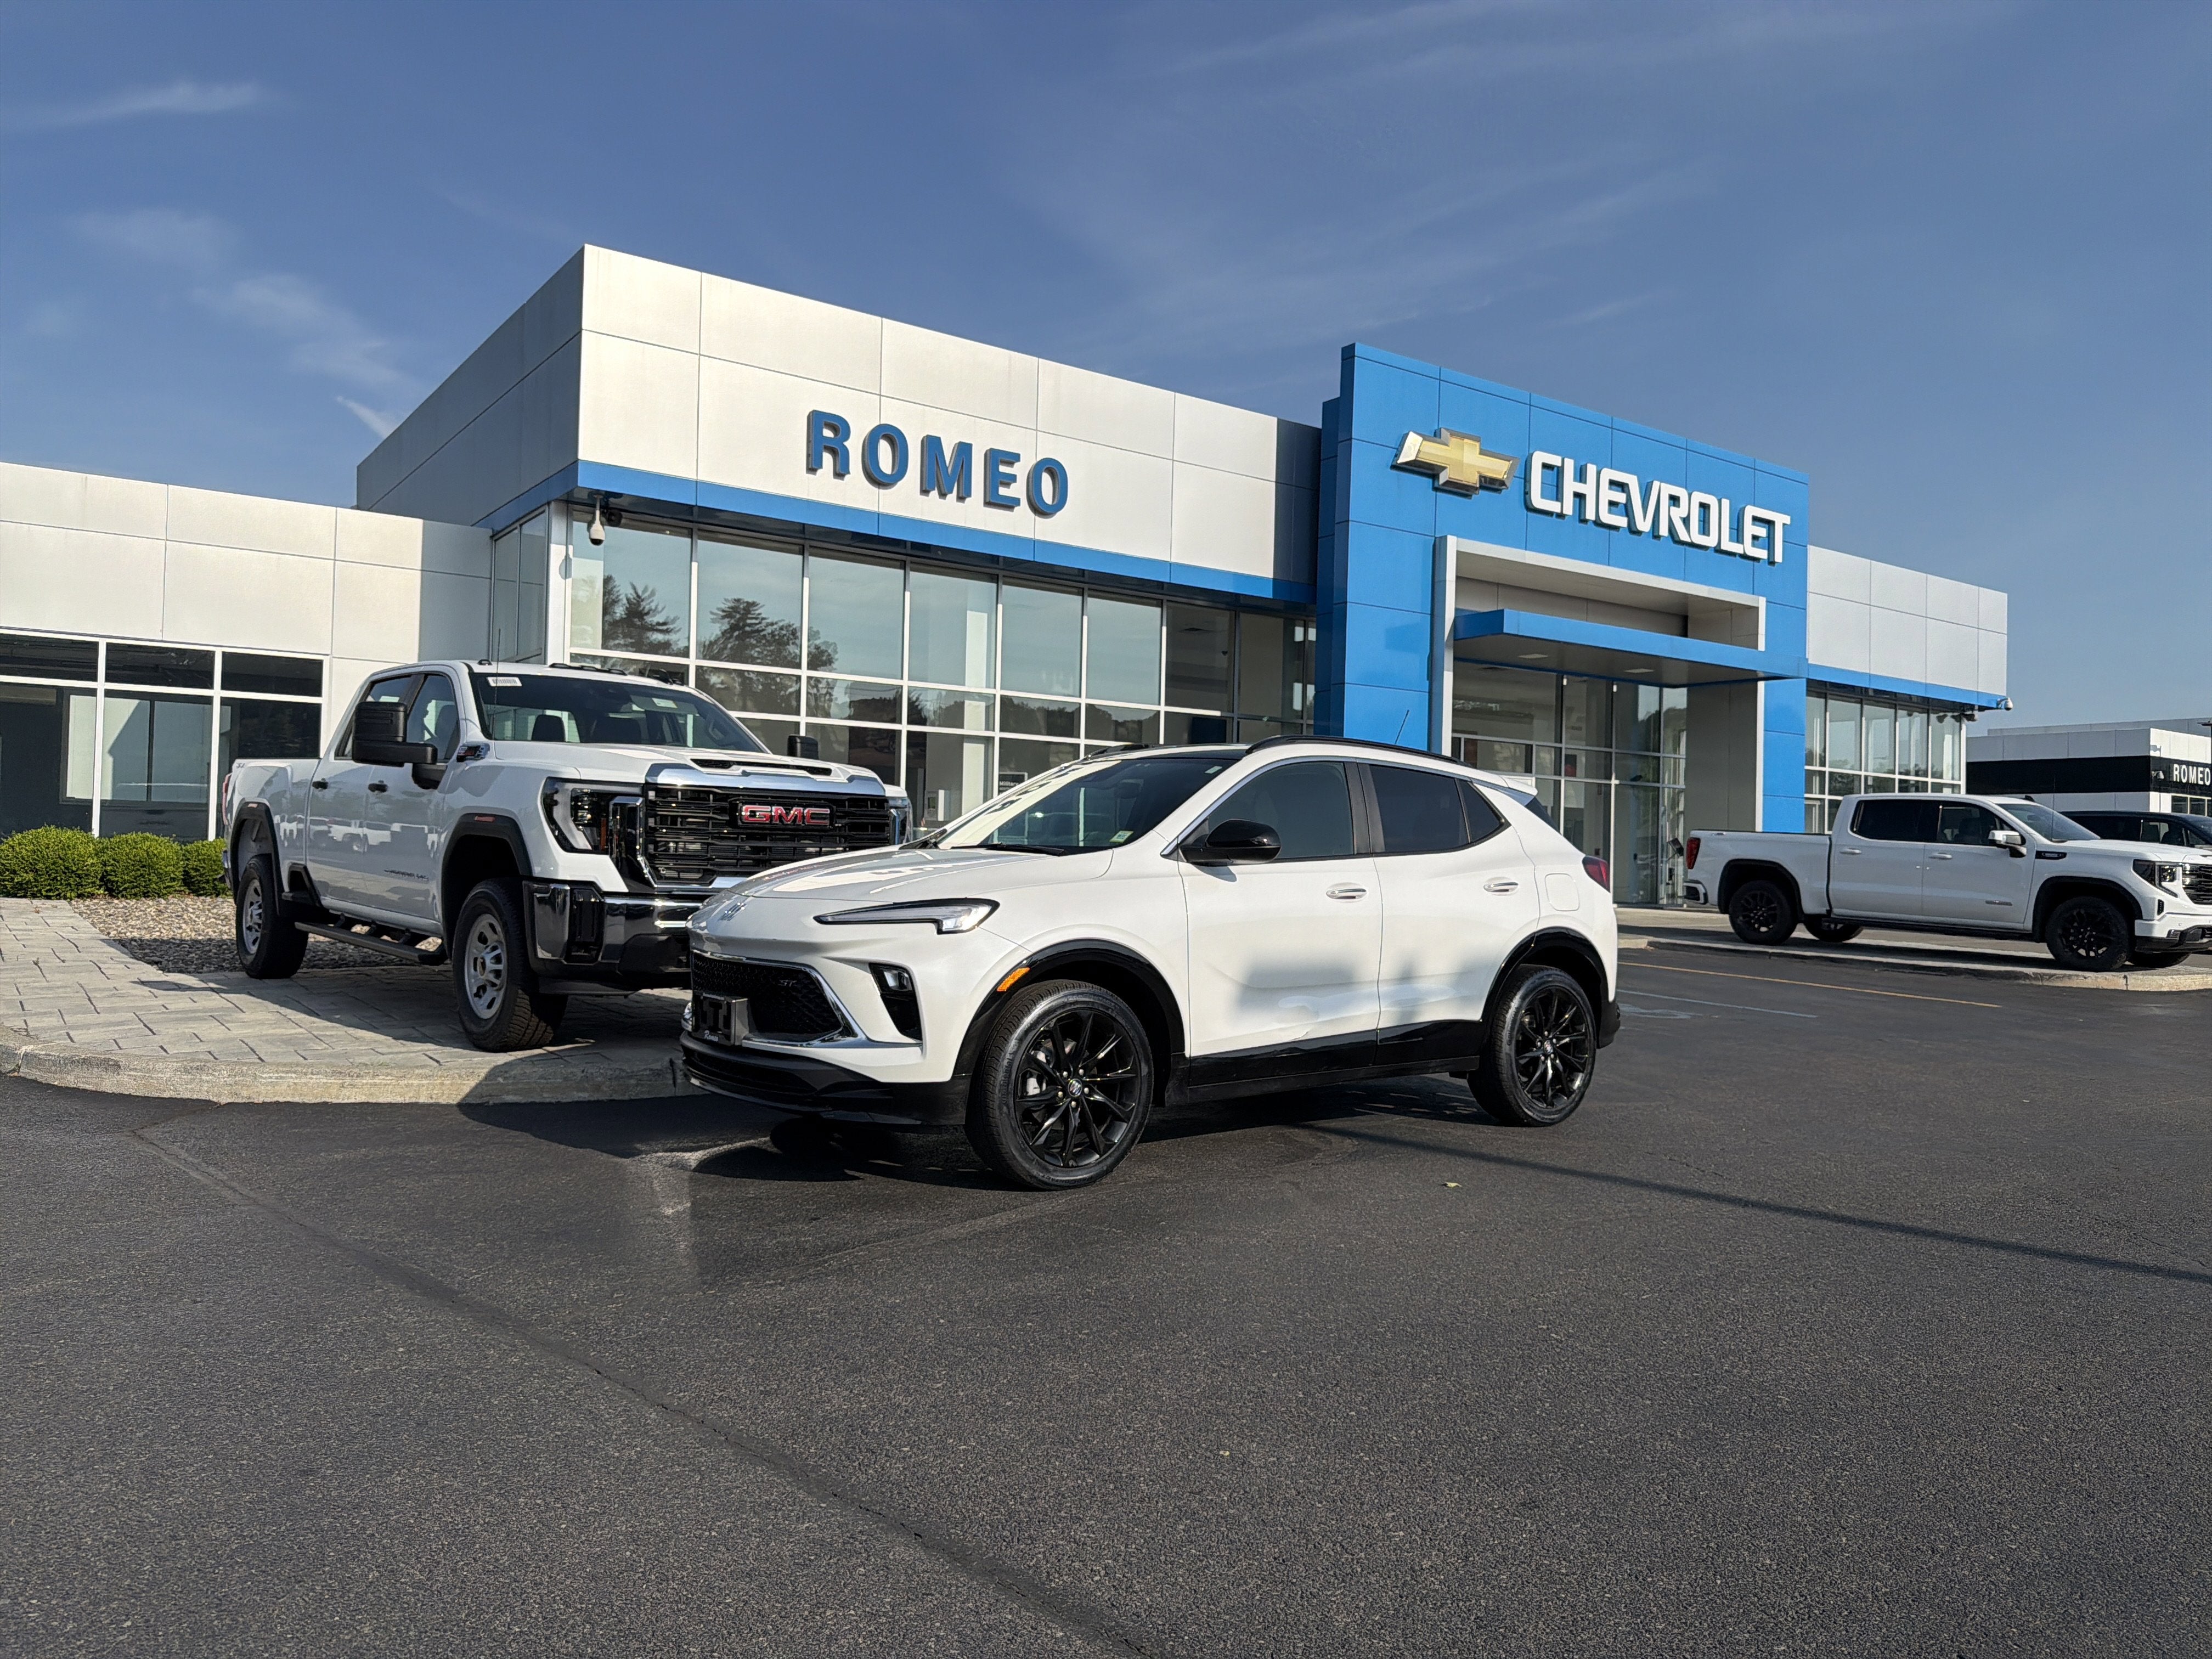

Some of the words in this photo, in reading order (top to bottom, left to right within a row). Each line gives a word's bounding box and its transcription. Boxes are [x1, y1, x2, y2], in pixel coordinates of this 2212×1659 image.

[806, 409, 1068, 516] ROMEO
[1527, 450, 1791, 564] CHEVROLET
[2173, 764, 2211, 786] ROMEO
[742, 805, 830, 825] GMC
